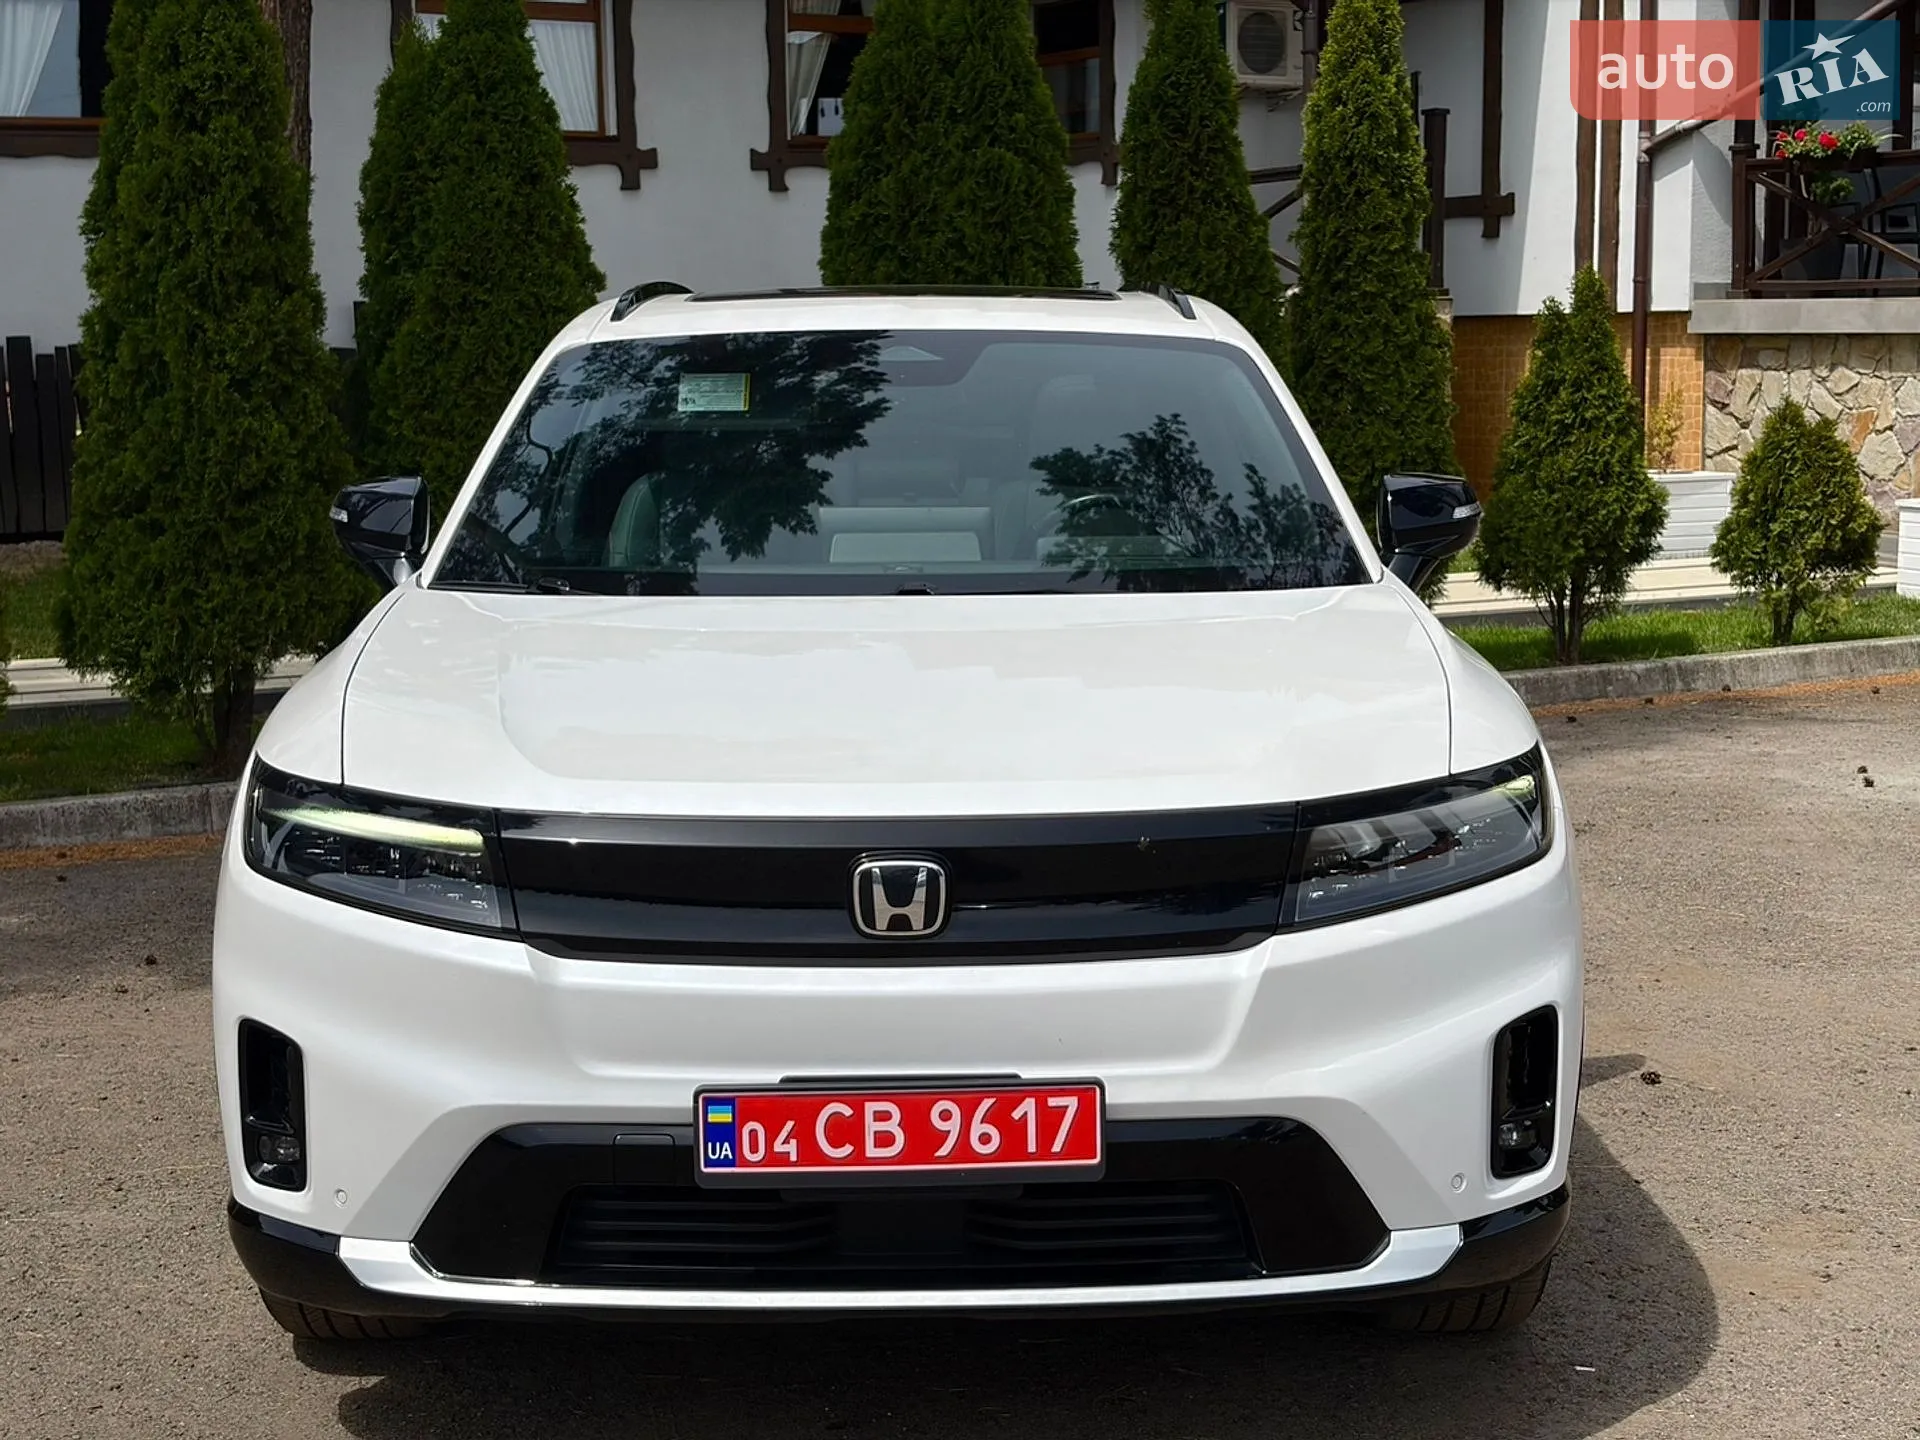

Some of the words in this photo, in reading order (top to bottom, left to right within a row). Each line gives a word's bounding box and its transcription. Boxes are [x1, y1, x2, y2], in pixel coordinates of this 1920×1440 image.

[742, 1120, 798, 1162] 04
[816, 1101, 905, 1158] CB
[930, 1096, 1079, 1158] 9617
[708, 1142, 734, 1160] UA
